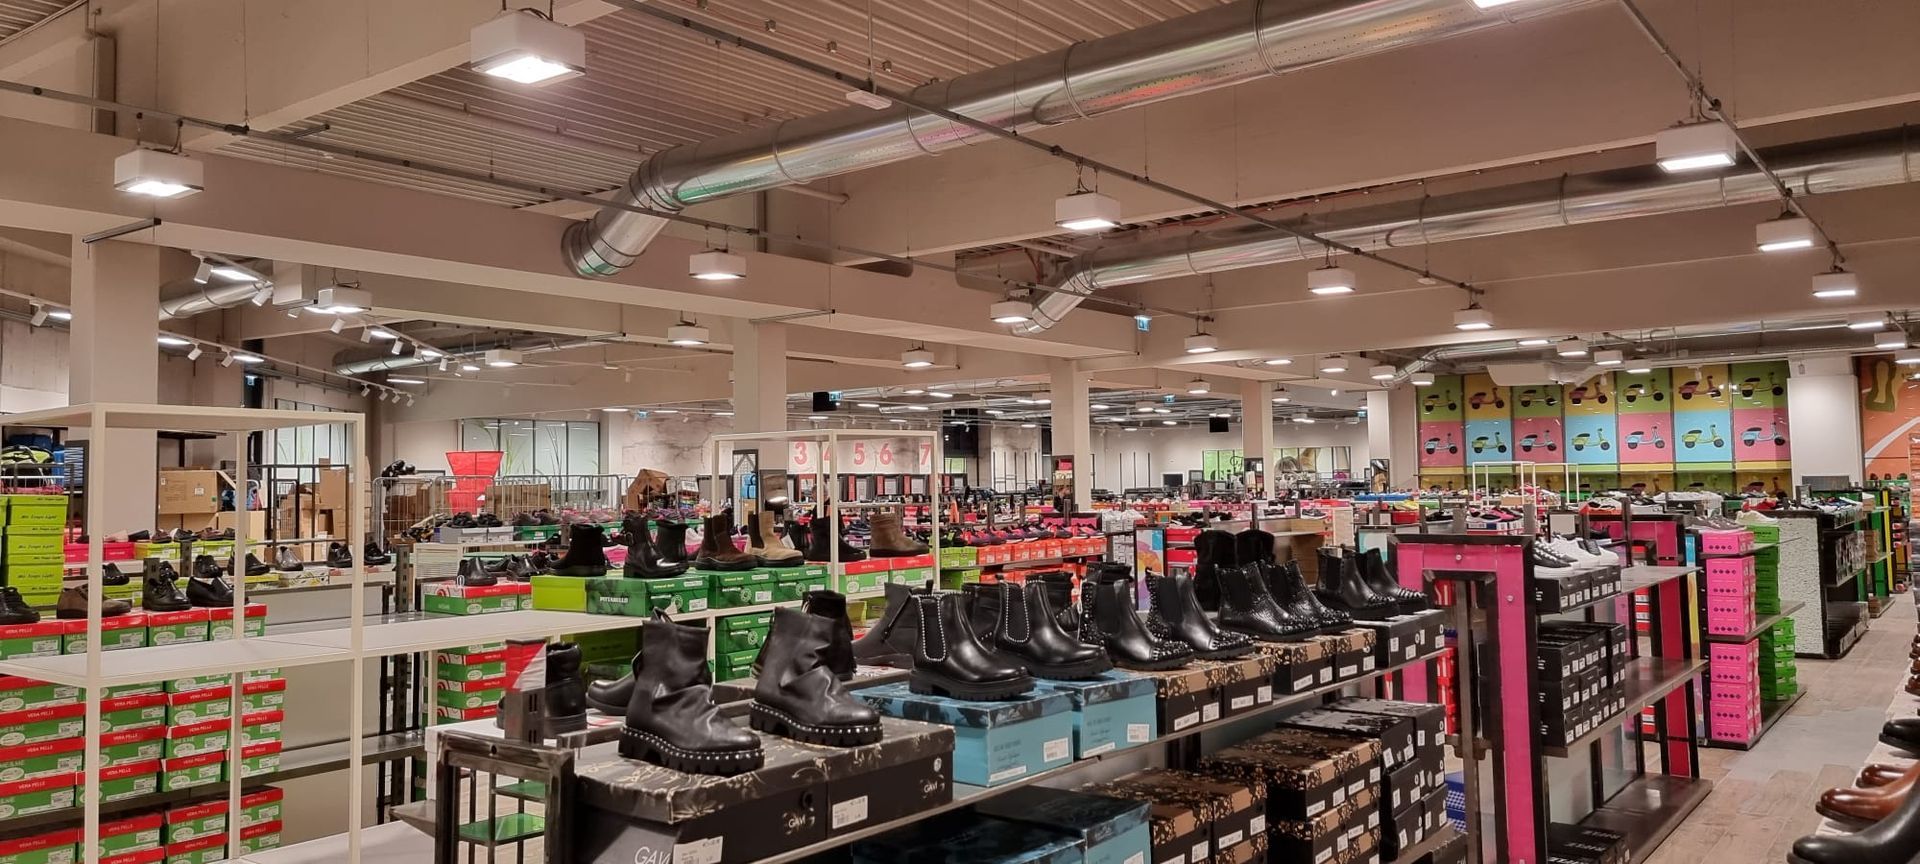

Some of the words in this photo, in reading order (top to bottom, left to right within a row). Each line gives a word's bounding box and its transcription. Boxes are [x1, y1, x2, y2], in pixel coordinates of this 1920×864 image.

[794, 441, 807, 465] 3
[854, 442, 865, 465] 5
[880, 443, 892, 465] 6
[920, 444, 932, 465] 7
